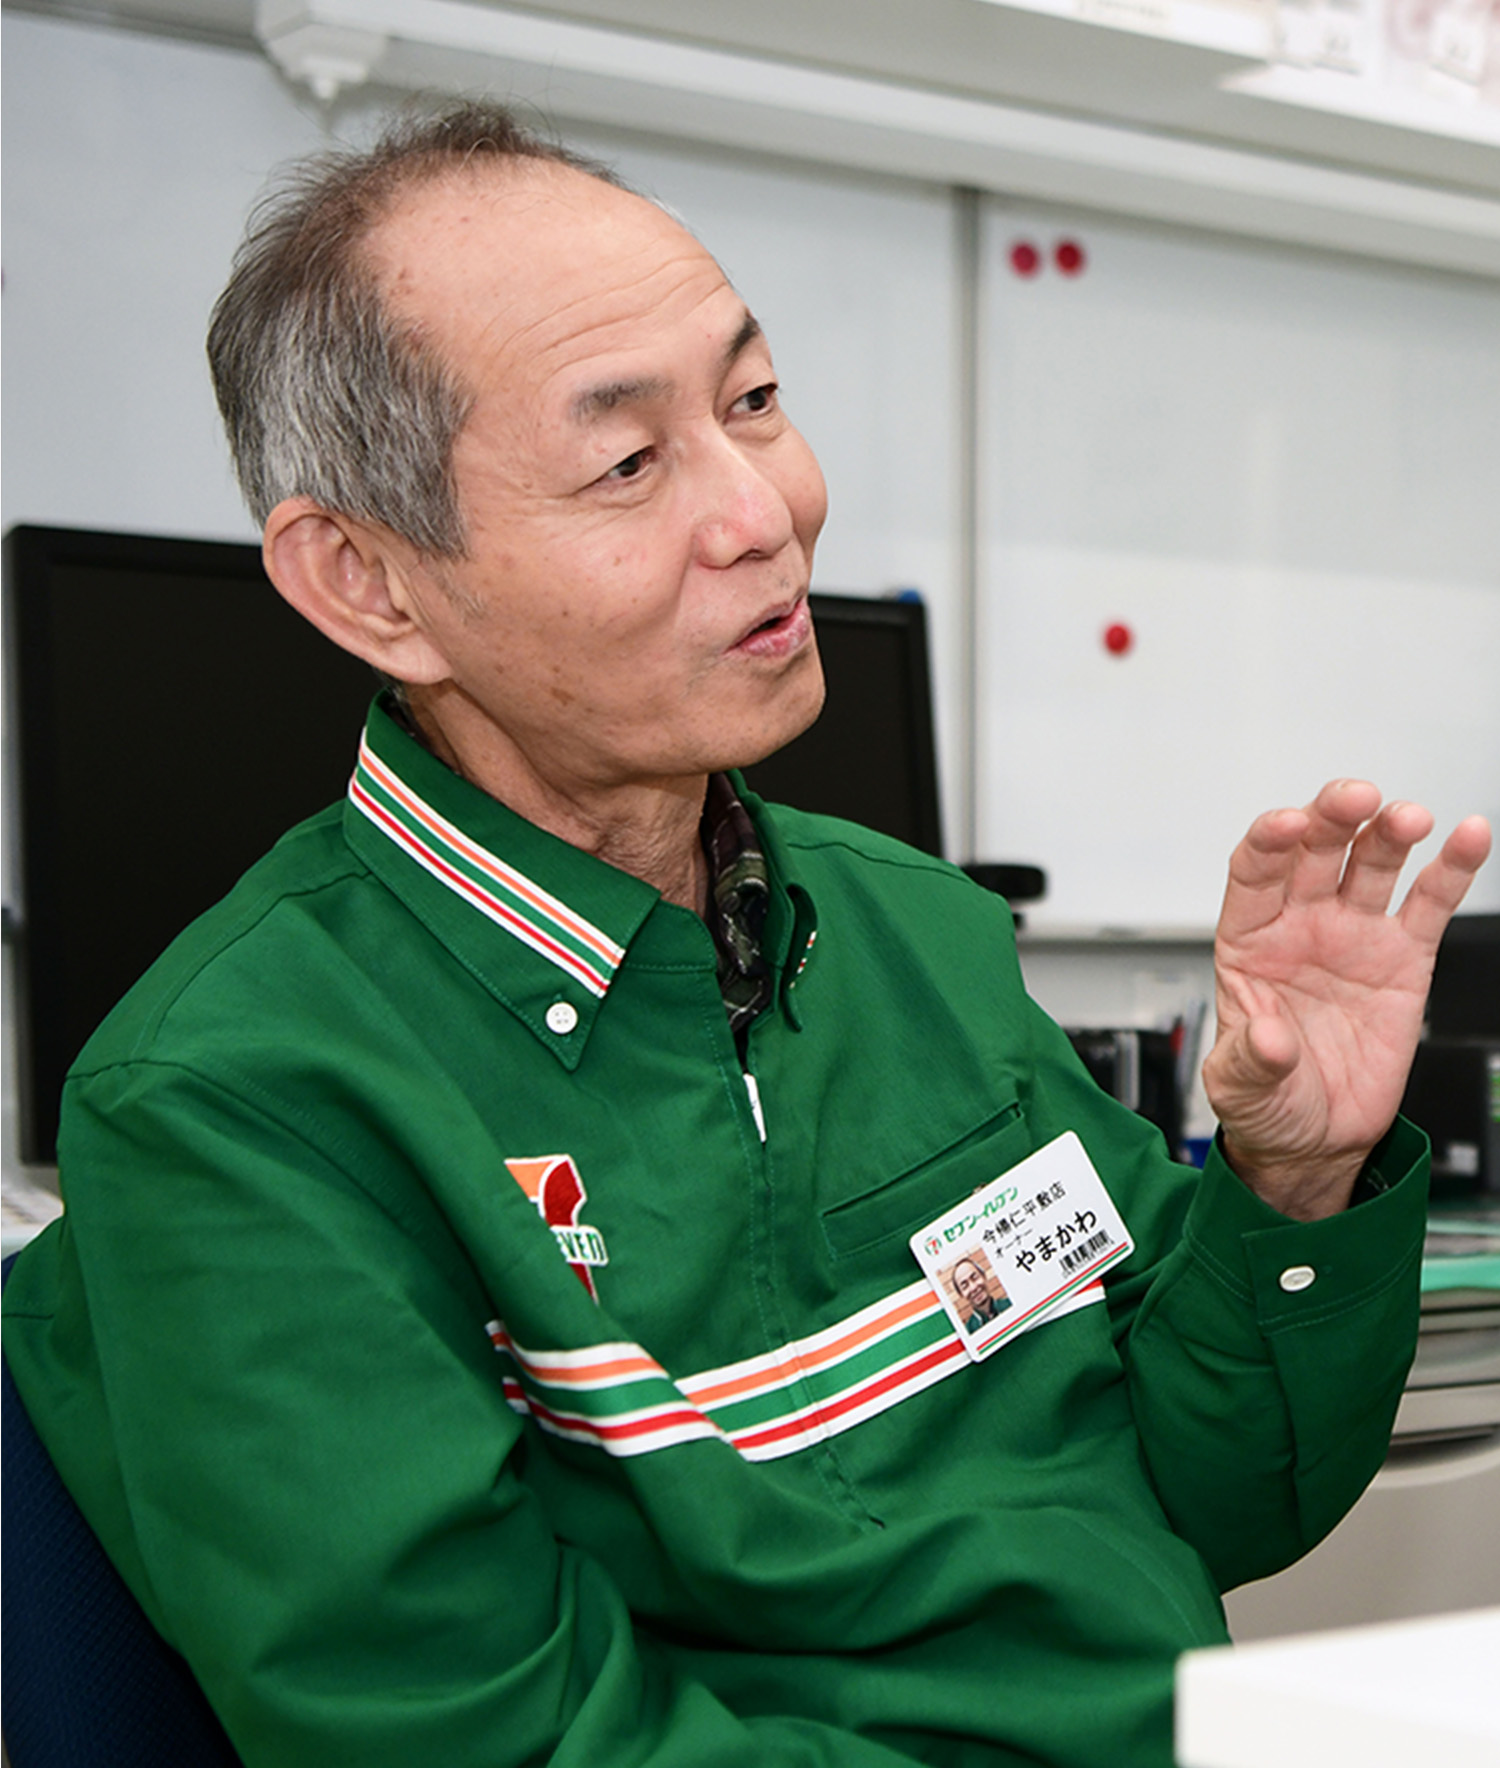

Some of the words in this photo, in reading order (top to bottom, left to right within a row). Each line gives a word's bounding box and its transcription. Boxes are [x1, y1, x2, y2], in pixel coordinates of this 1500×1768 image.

[995, 1229, 1033, 1258] オーナー
[1015, 1210, 1097, 1273] やまかわ
